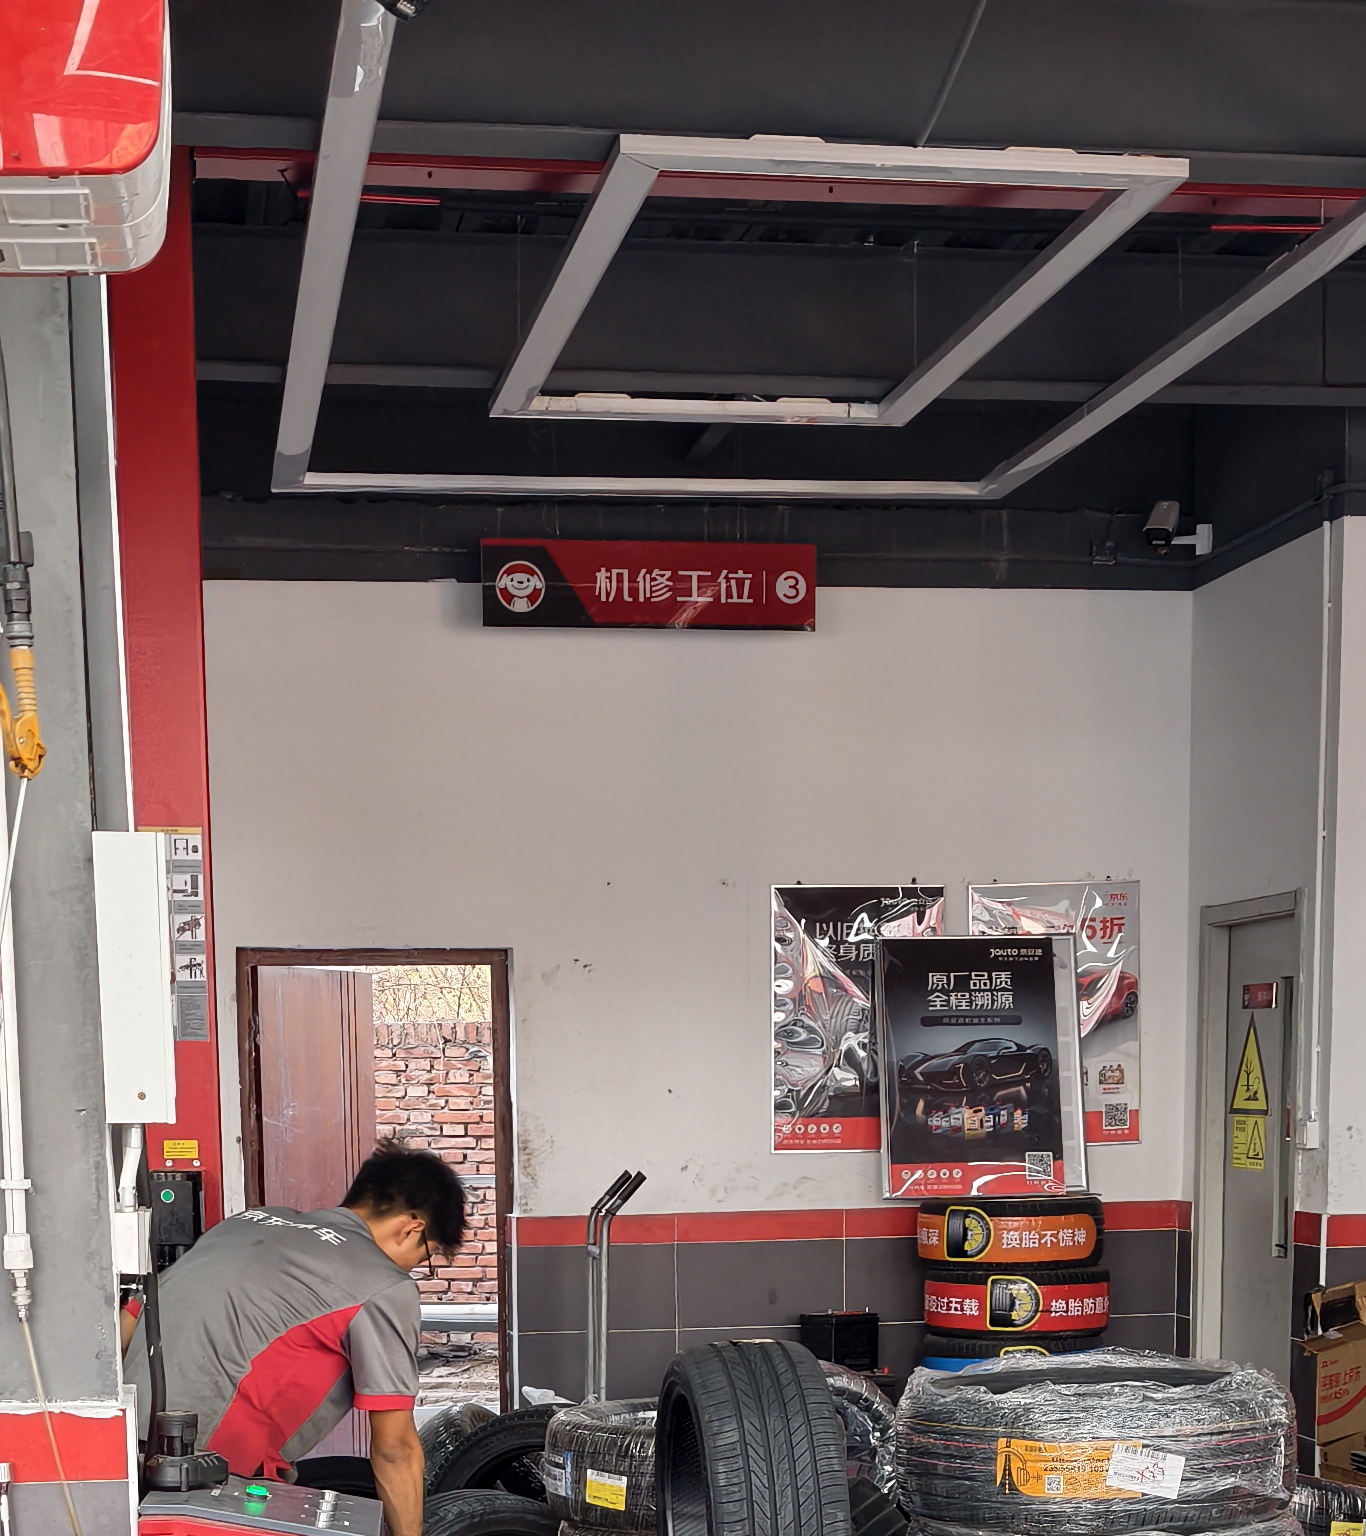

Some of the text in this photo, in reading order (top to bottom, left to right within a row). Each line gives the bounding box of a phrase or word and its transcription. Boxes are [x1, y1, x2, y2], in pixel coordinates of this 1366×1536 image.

[595, 567, 753, 604] 机修工位
[927, 972, 1013, 990] 原厂品质
[927, 991, 1014, 1010] 全程溯源
[1002, 1229, 1087, 1248] 换胎不慌神
